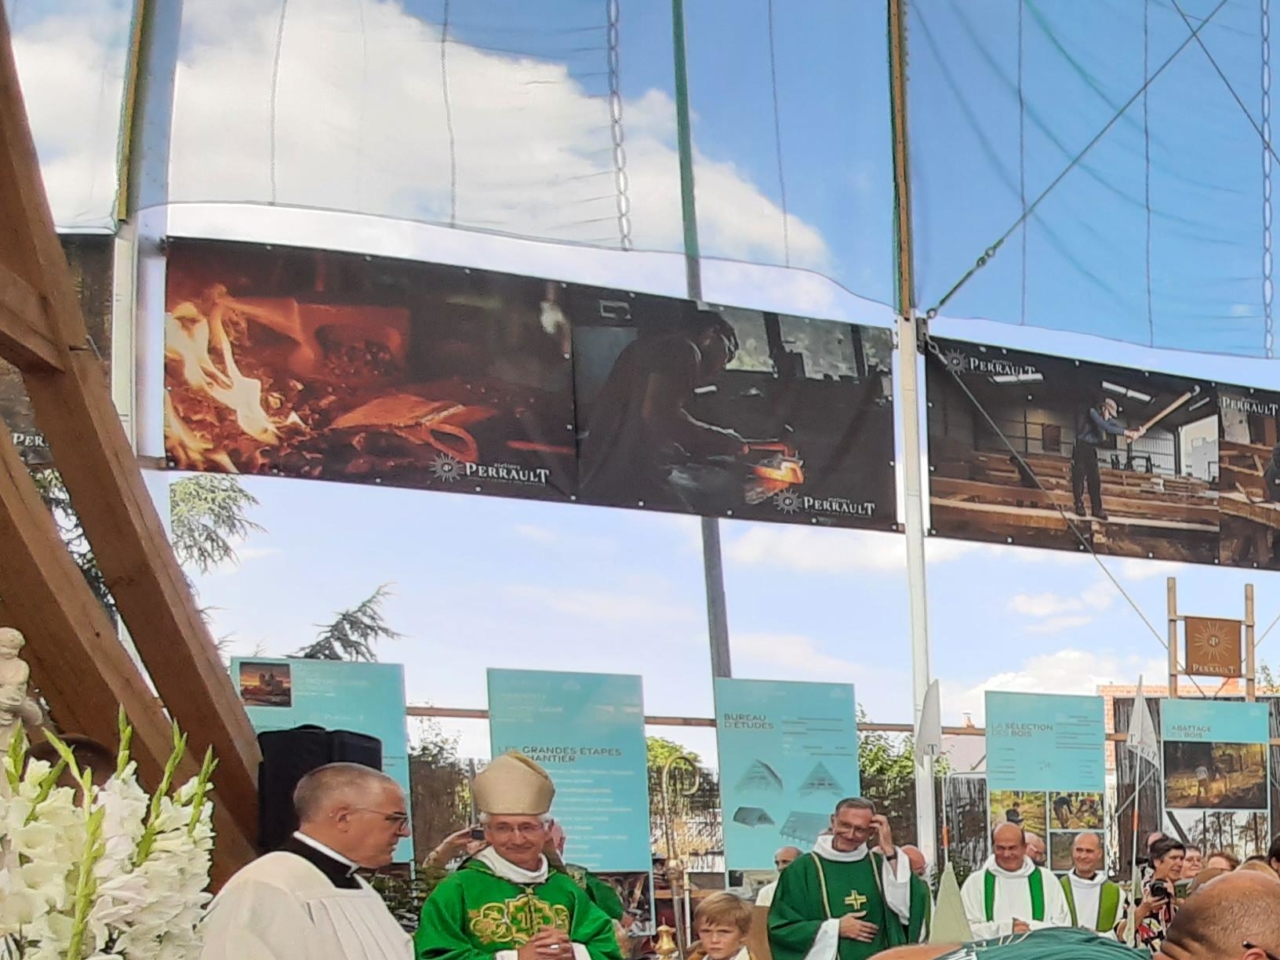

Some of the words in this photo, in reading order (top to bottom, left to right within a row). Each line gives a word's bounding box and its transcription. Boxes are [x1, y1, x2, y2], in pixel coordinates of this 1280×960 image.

[969, 357, 1036, 375] PERRAULT
[1222, 396, 1279, 417] PERRAULT
[12, 432, 49, 447] PER
[465, 461, 550, 484] PERRAULT
[803, 496, 876, 516] PERRAULT
[724, 713, 767, 721] BUREAU
[522, 745, 577, 756] GRANDES
[524, 754, 576, 763] HANTIER
